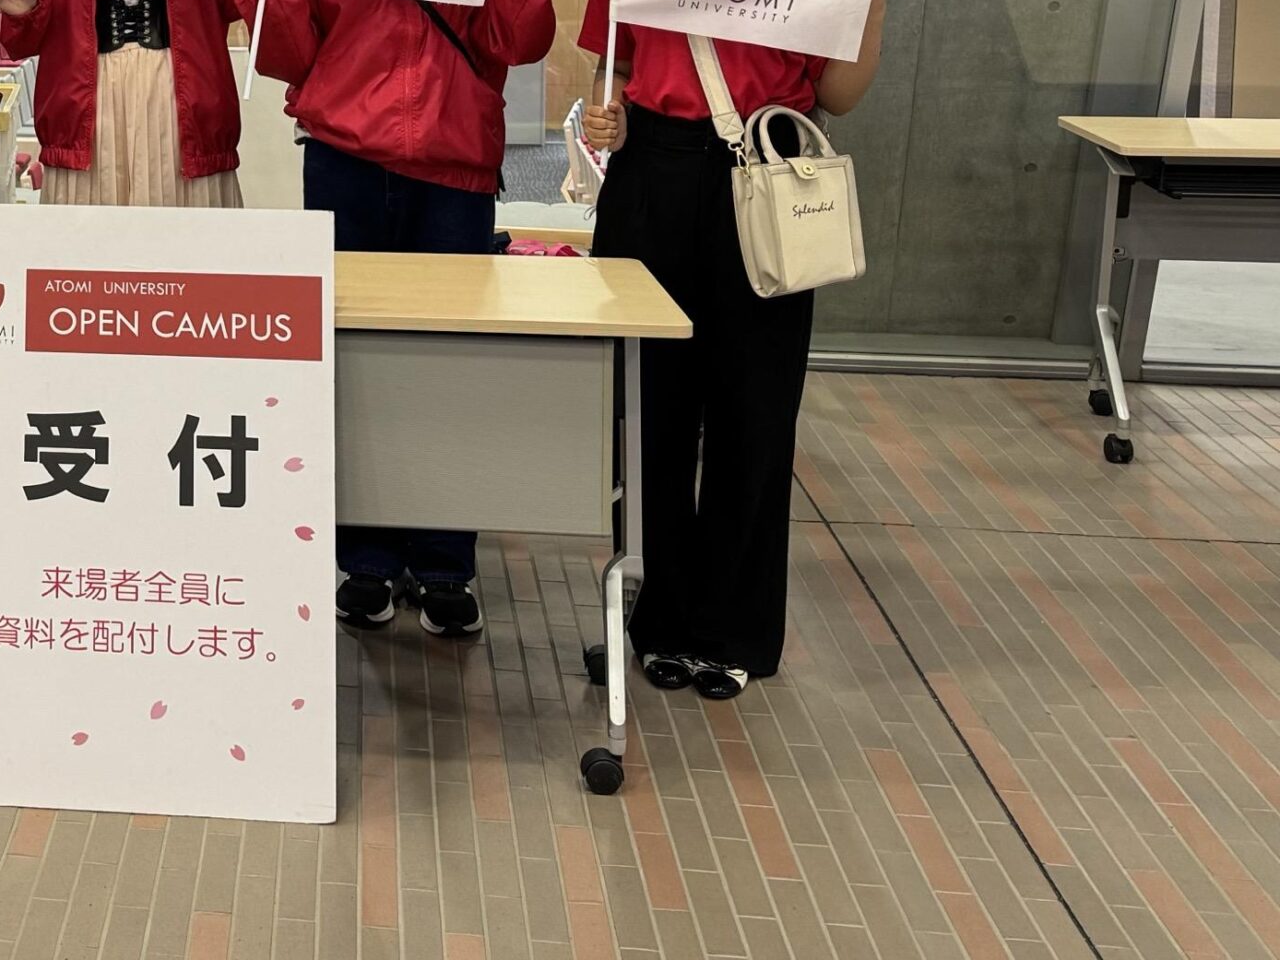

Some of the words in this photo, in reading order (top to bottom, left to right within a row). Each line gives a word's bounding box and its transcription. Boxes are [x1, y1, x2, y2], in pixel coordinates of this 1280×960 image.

[677, 0, 790, 24] UNIVERSITY
[792, 200, 835, 220] Splendid
[44, 279, 92, 294] ATOMI
[103, 281, 186, 297] UNIVERSITY
[48, 306, 140, 337] OPEN
[151, 310, 293, 343] CAMPUS
[40, 566, 247, 608] 来場者全員に
